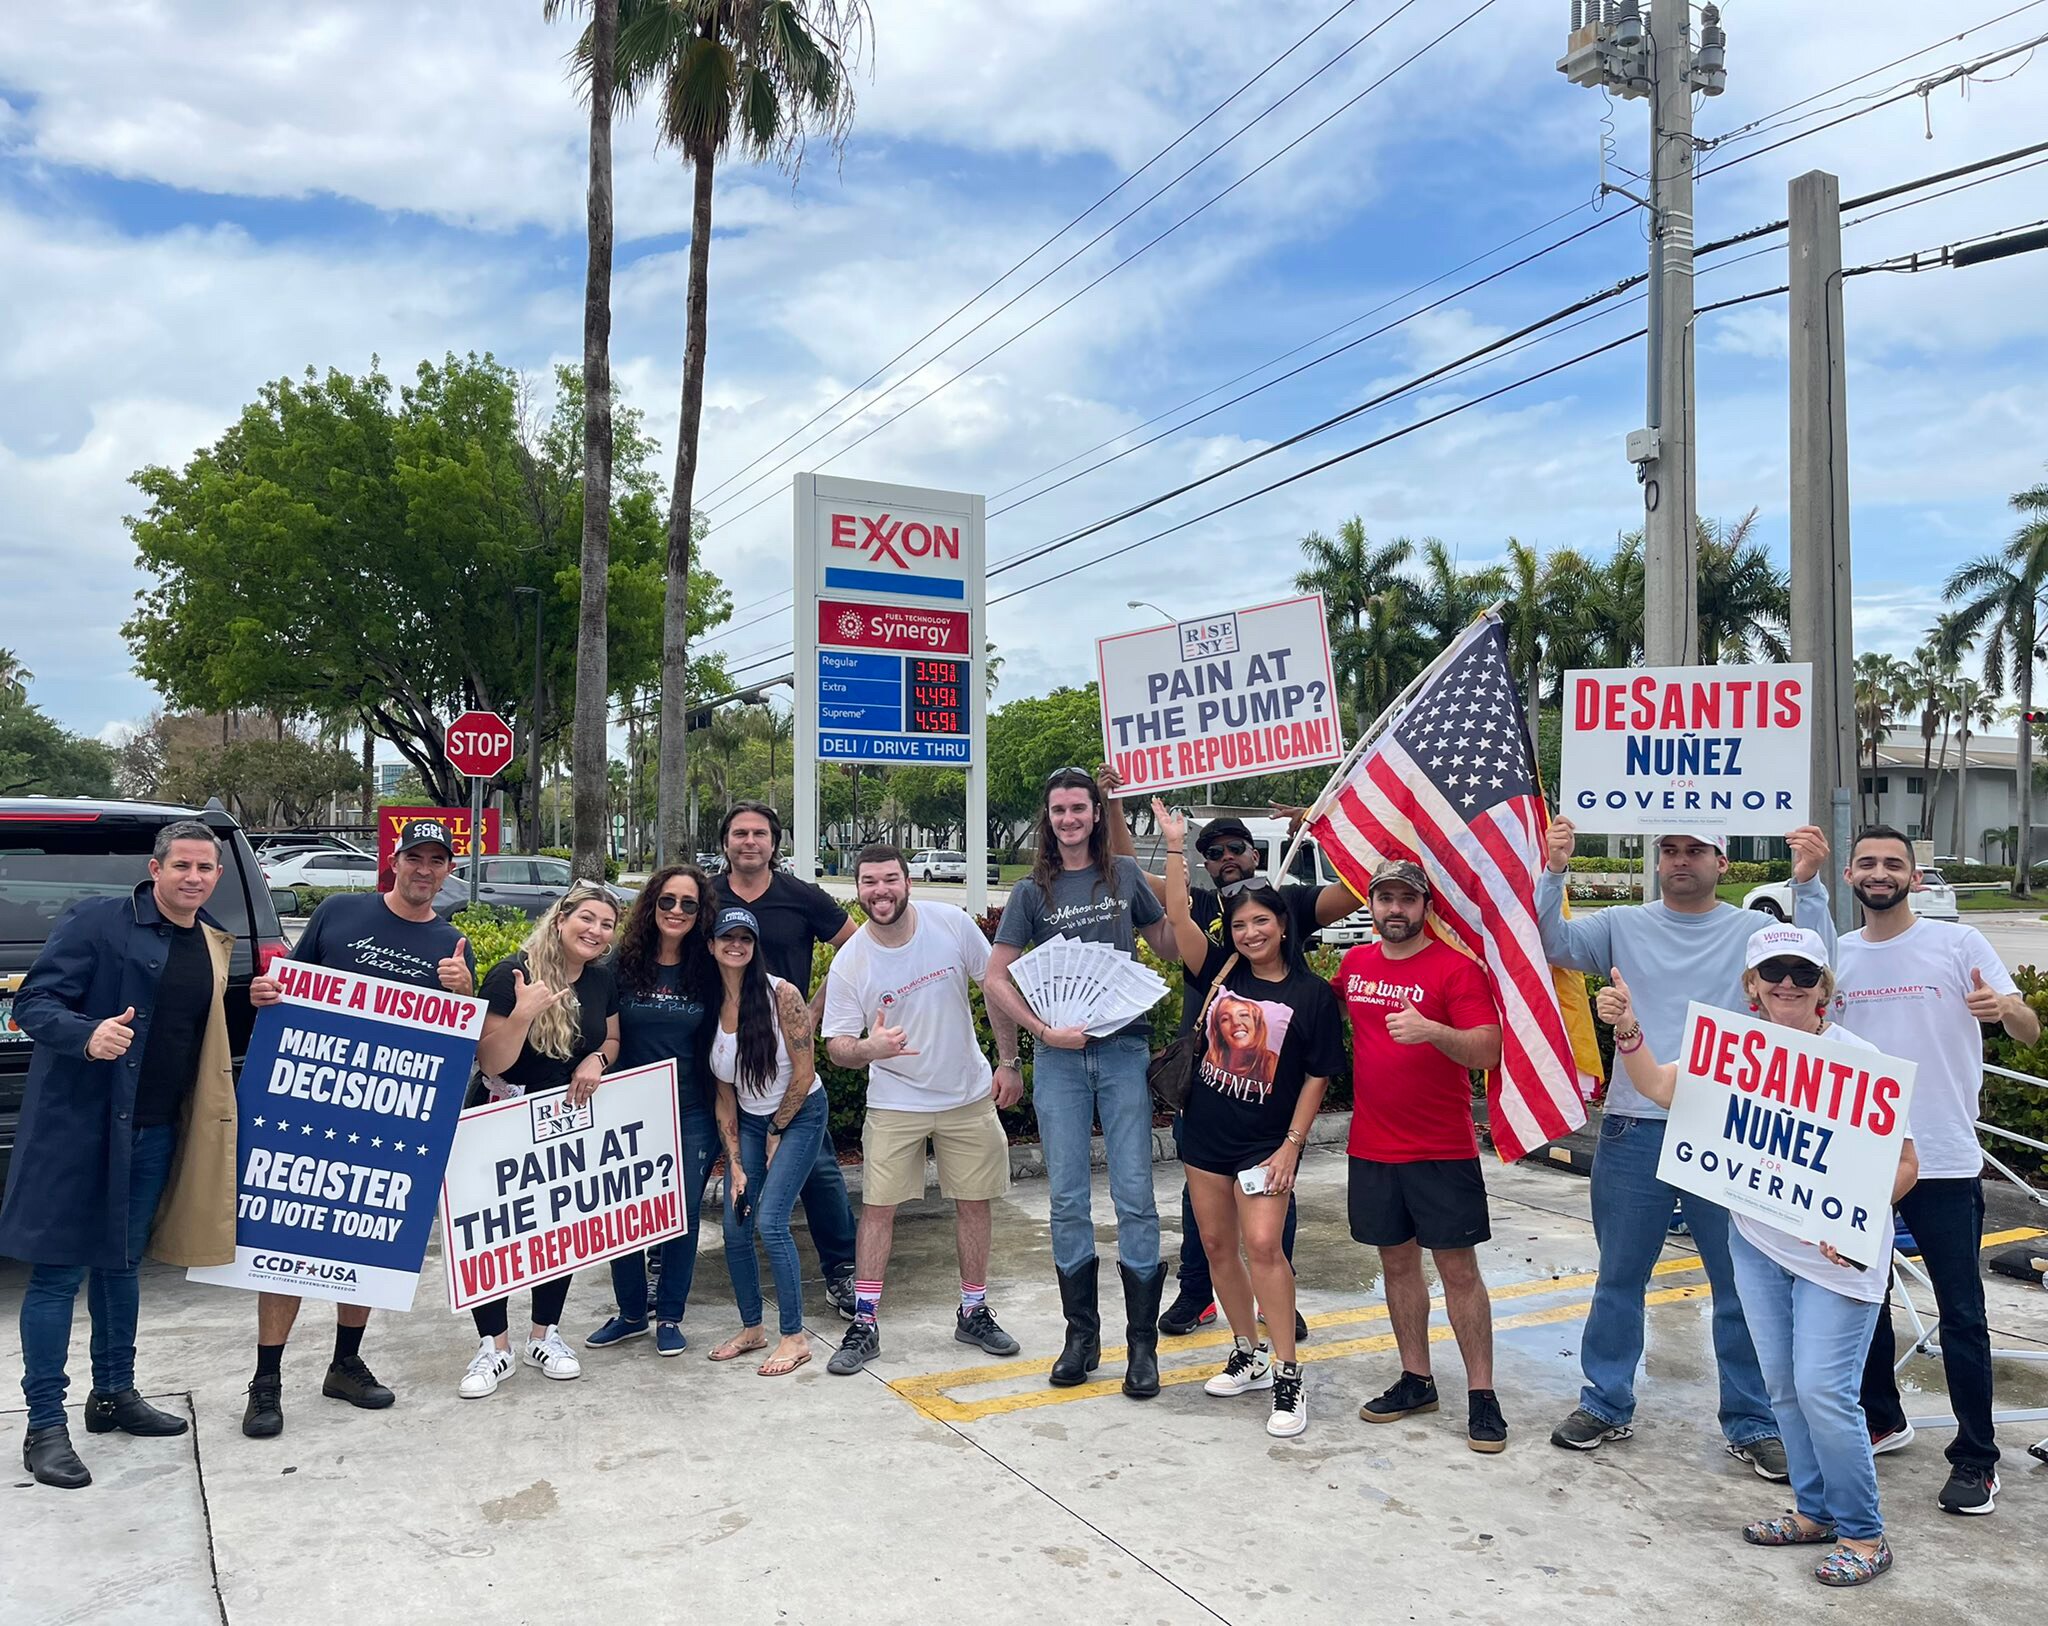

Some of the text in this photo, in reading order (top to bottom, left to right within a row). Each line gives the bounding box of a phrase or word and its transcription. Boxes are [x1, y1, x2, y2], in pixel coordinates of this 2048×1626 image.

[831, 513, 959, 570] EXXON
[871, 617, 951, 647] Synergy
[885, 613, 951, 625] FUEL TECHNOLOGY
[1196, 638, 1223, 656] NY
[822, 656, 858, 668] Regular
[1147, 648, 1292, 705] PAIN AT
[822, 682, 847, 692] Extra
[1112, 680, 1327, 747] THE PUMP?
[449, 730, 509, 757] STOP
[823, 739, 857, 753] DELI
[873, 740, 919, 756] DRIVE
[925, 742, 966, 757] THRU
[1115, 717, 1333, 786] VOTE REPUBLICAN!
[1626, 733, 1742, 776] NUÑEZ
[1670, 780, 1694, 788] FOR
[1577, 790, 1793, 810] GOVERNOR
[1043, 896, 1128, 925] Melrose Strng
[1763, 931, 1803, 940] Women
[347, 936, 434, 969] American
[355, 951, 429, 978] Patriot
[929, 968, 947, 979] PARTY
[1347, 974, 1424, 1002] Broward
[278, 966, 477, 1030] HAVE A VISION?
[1386, 1000, 1405, 1009] FIRS
[1848, 985, 1924, 998] REPUBLICAN PARTY
[278, 1027, 445, 1081] MAKE A RIGHT
[267, 1058, 437, 1122] DECISION!
[1199, 1060, 1272, 1105] BRITNEY
[549, 1114, 577, 1135] NY
[1723, 1093, 1834, 1175] NUÑEZ
[495, 1120, 644, 1197] PAIN AT
[1759, 1157, 1782, 1173] FOR
[243, 1148, 413, 1211] REGISTER
[1675, 1141, 1868, 1232] GOVERNOR
[454, 1153, 674, 1251] THE PUMP?
[238, 1194, 403, 1243] TO VOTE TODAY
[460, 1191, 677, 1298] VOTE REPUBLICAN!
[272, 1276, 298, 1284] CITIZENS
[299, 1279, 330, 1289] DEFENDING
[331, 1284, 356, 1292] FREEDOM
